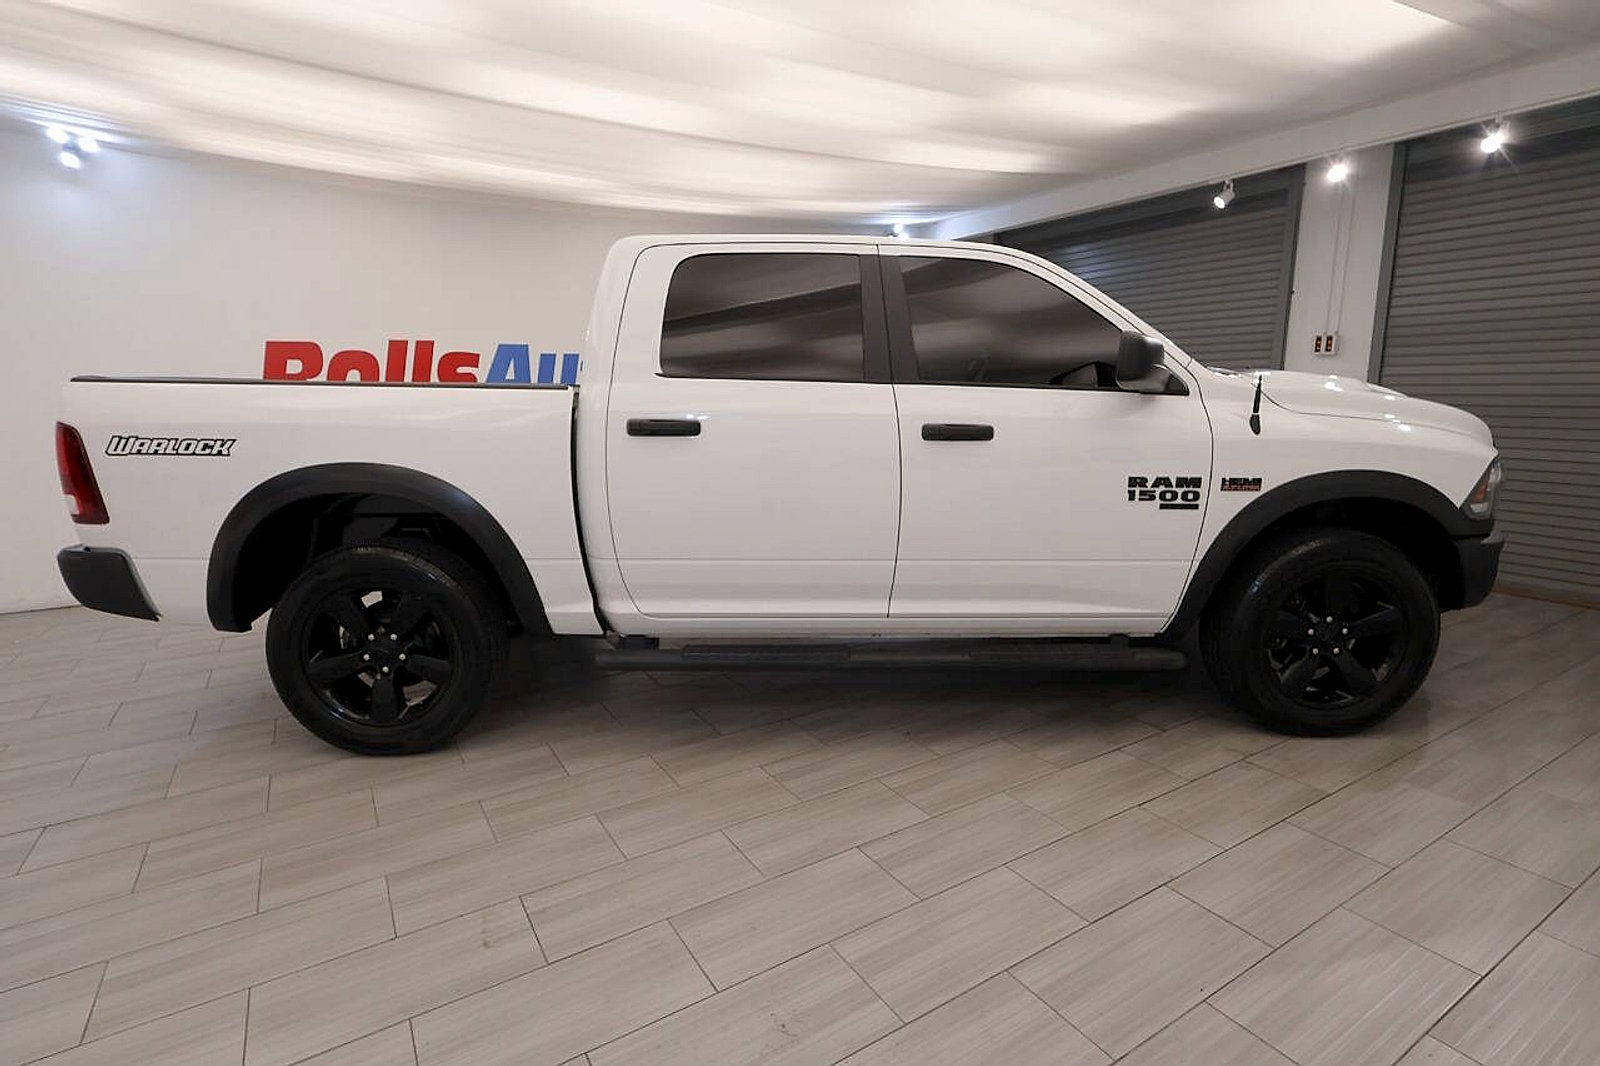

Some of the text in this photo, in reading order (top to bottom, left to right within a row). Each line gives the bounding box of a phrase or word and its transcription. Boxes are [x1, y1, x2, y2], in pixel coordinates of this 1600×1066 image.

[262, 340, 583, 383] RollsAu
[105, 435, 237, 456] WARLOCK
[1128, 477, 1202, 488] RAM
[1220, 477, 1262, 489] HEMI
[1128, 490, 1200, 502] 1500
